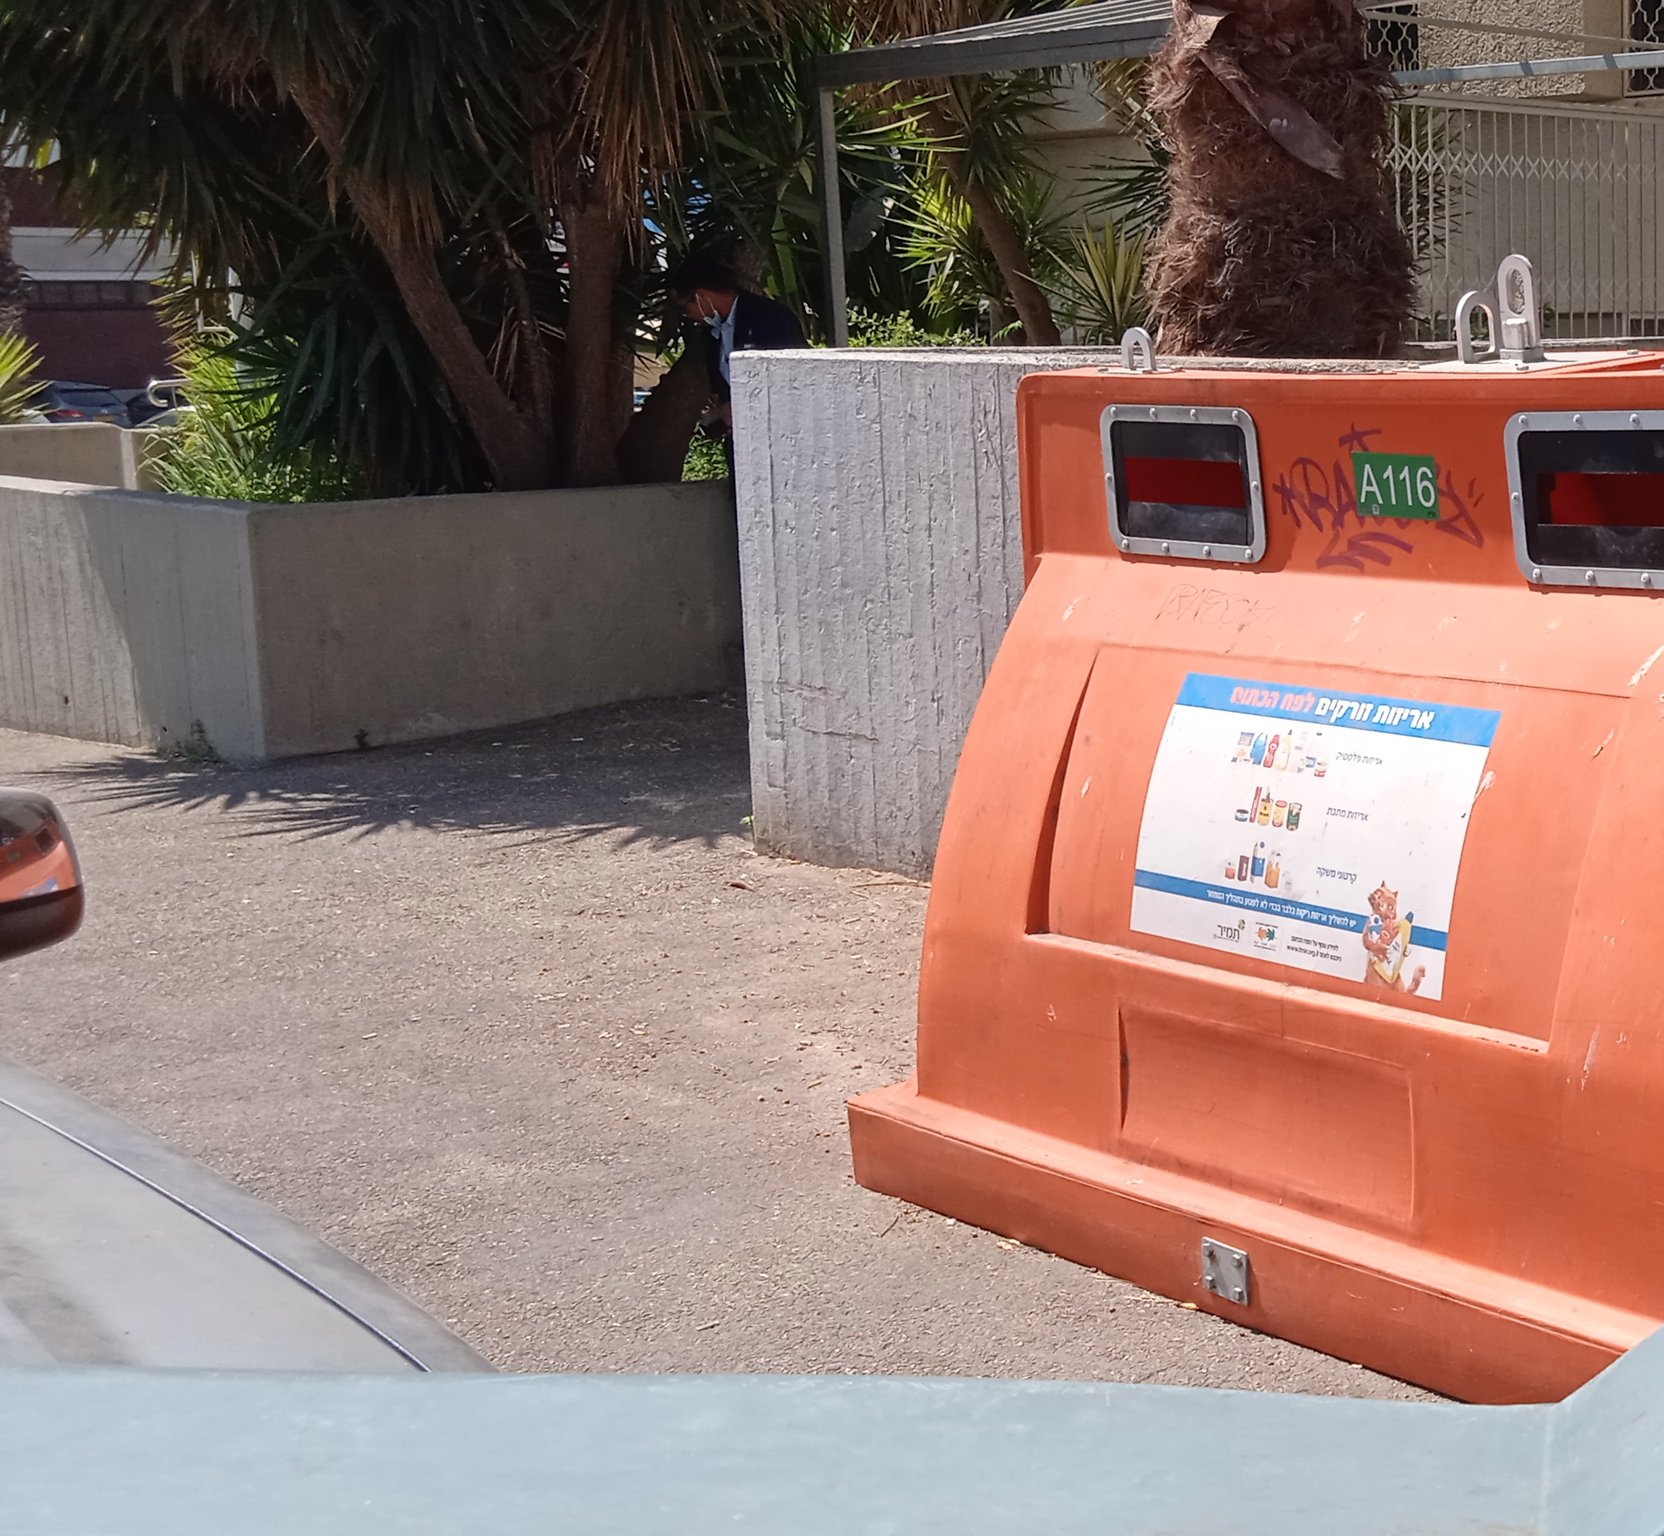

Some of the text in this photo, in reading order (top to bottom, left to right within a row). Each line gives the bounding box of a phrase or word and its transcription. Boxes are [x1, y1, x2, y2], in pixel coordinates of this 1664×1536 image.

[1360, 463, 1436, 508] A116
[1230, 686, 1436, 730] אריזות זורקים לפח הכתום
[1347, 811, 1369, 821] אריזות
[1217, 924, 1240, 940] תמיר
